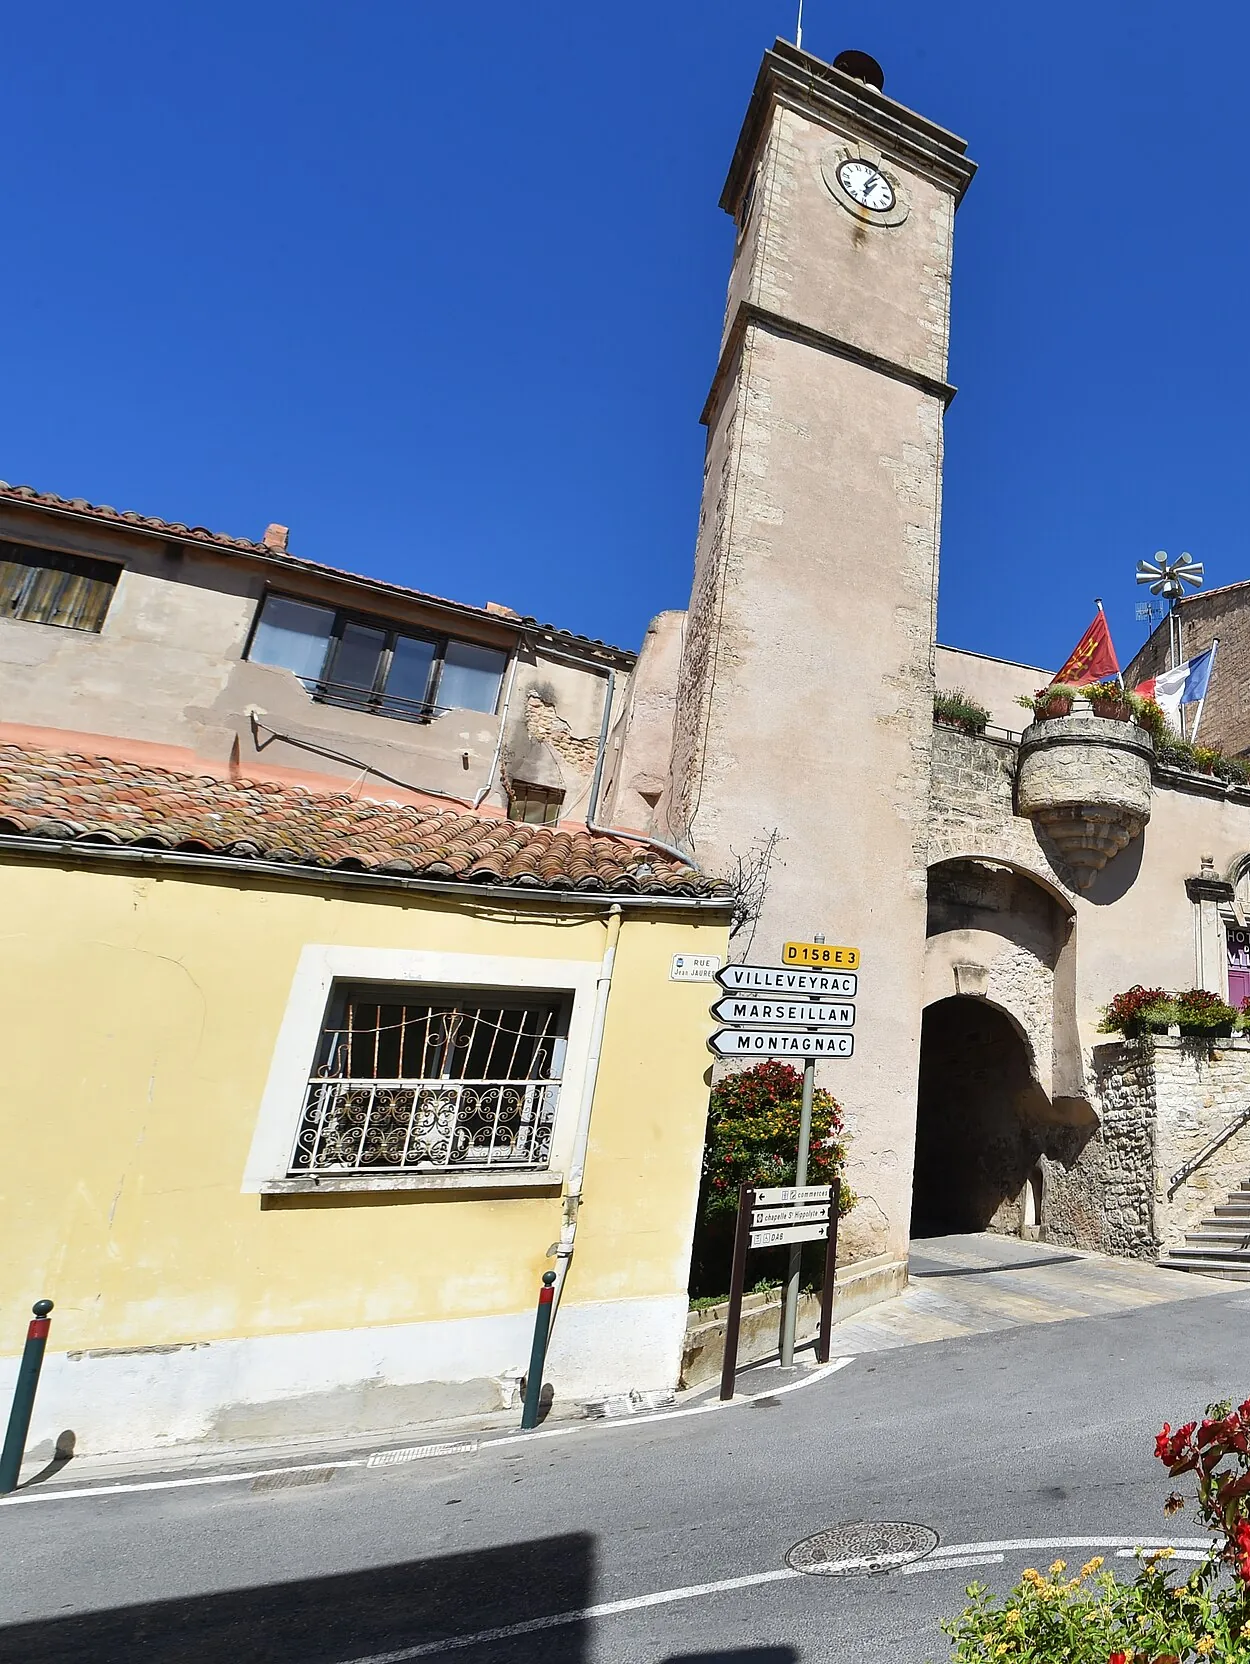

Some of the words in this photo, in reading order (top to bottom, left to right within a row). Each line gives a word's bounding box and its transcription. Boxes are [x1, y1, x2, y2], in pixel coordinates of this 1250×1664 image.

[734, 971, 850, 990] VILLEVEYRAC
[734, 1004, 849, 1021] MARSEILLAN
[738, 1036, 846, 1052] MONTAGNAC
[765, 1213, 786, 1222] chapelle
[794, 1210, 818, 1219] Hippolyte
[771, 1233, 783, 1241] DAB
